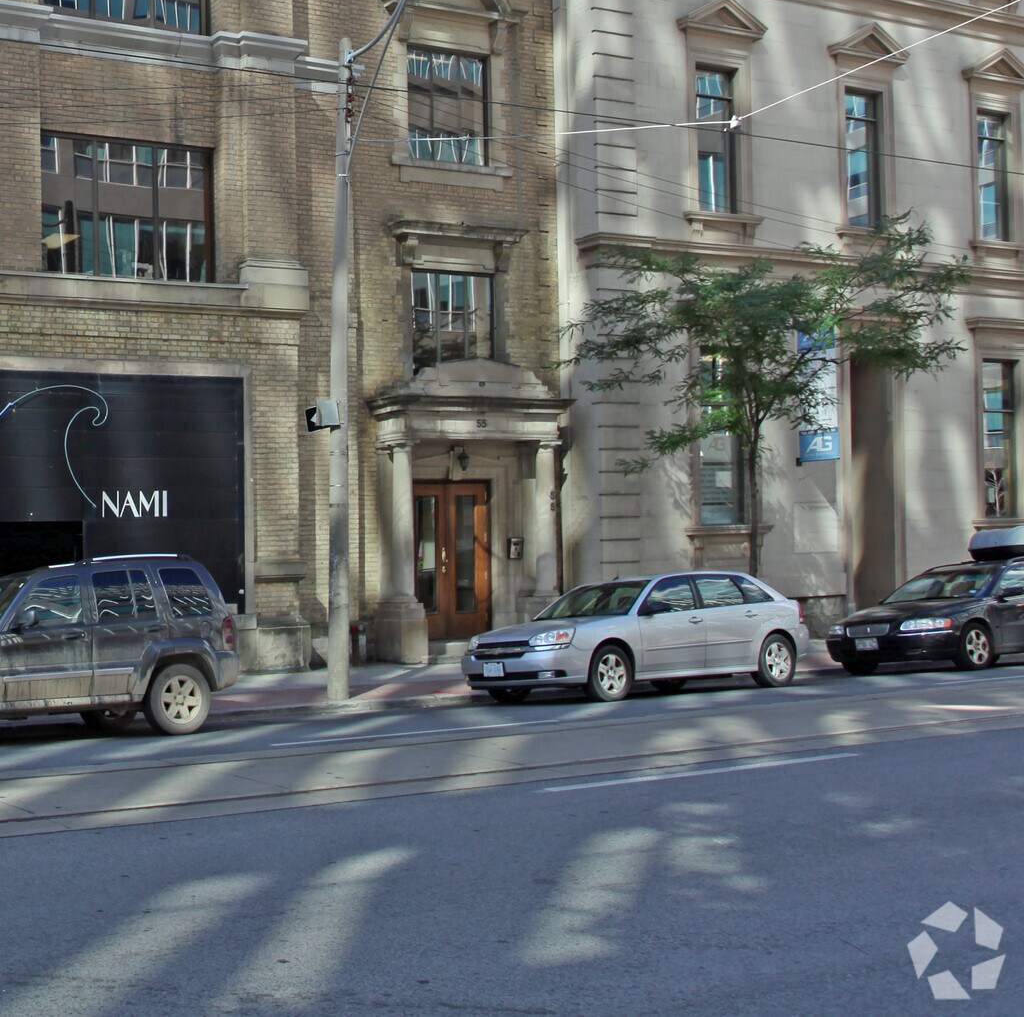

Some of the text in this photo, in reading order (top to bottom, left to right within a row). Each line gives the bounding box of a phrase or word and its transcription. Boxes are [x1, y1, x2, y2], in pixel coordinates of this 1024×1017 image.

[476, 419, 487, 428] 55
[806, 435, 833, 454] AG
[102, 490, 168, 518] NAMI
